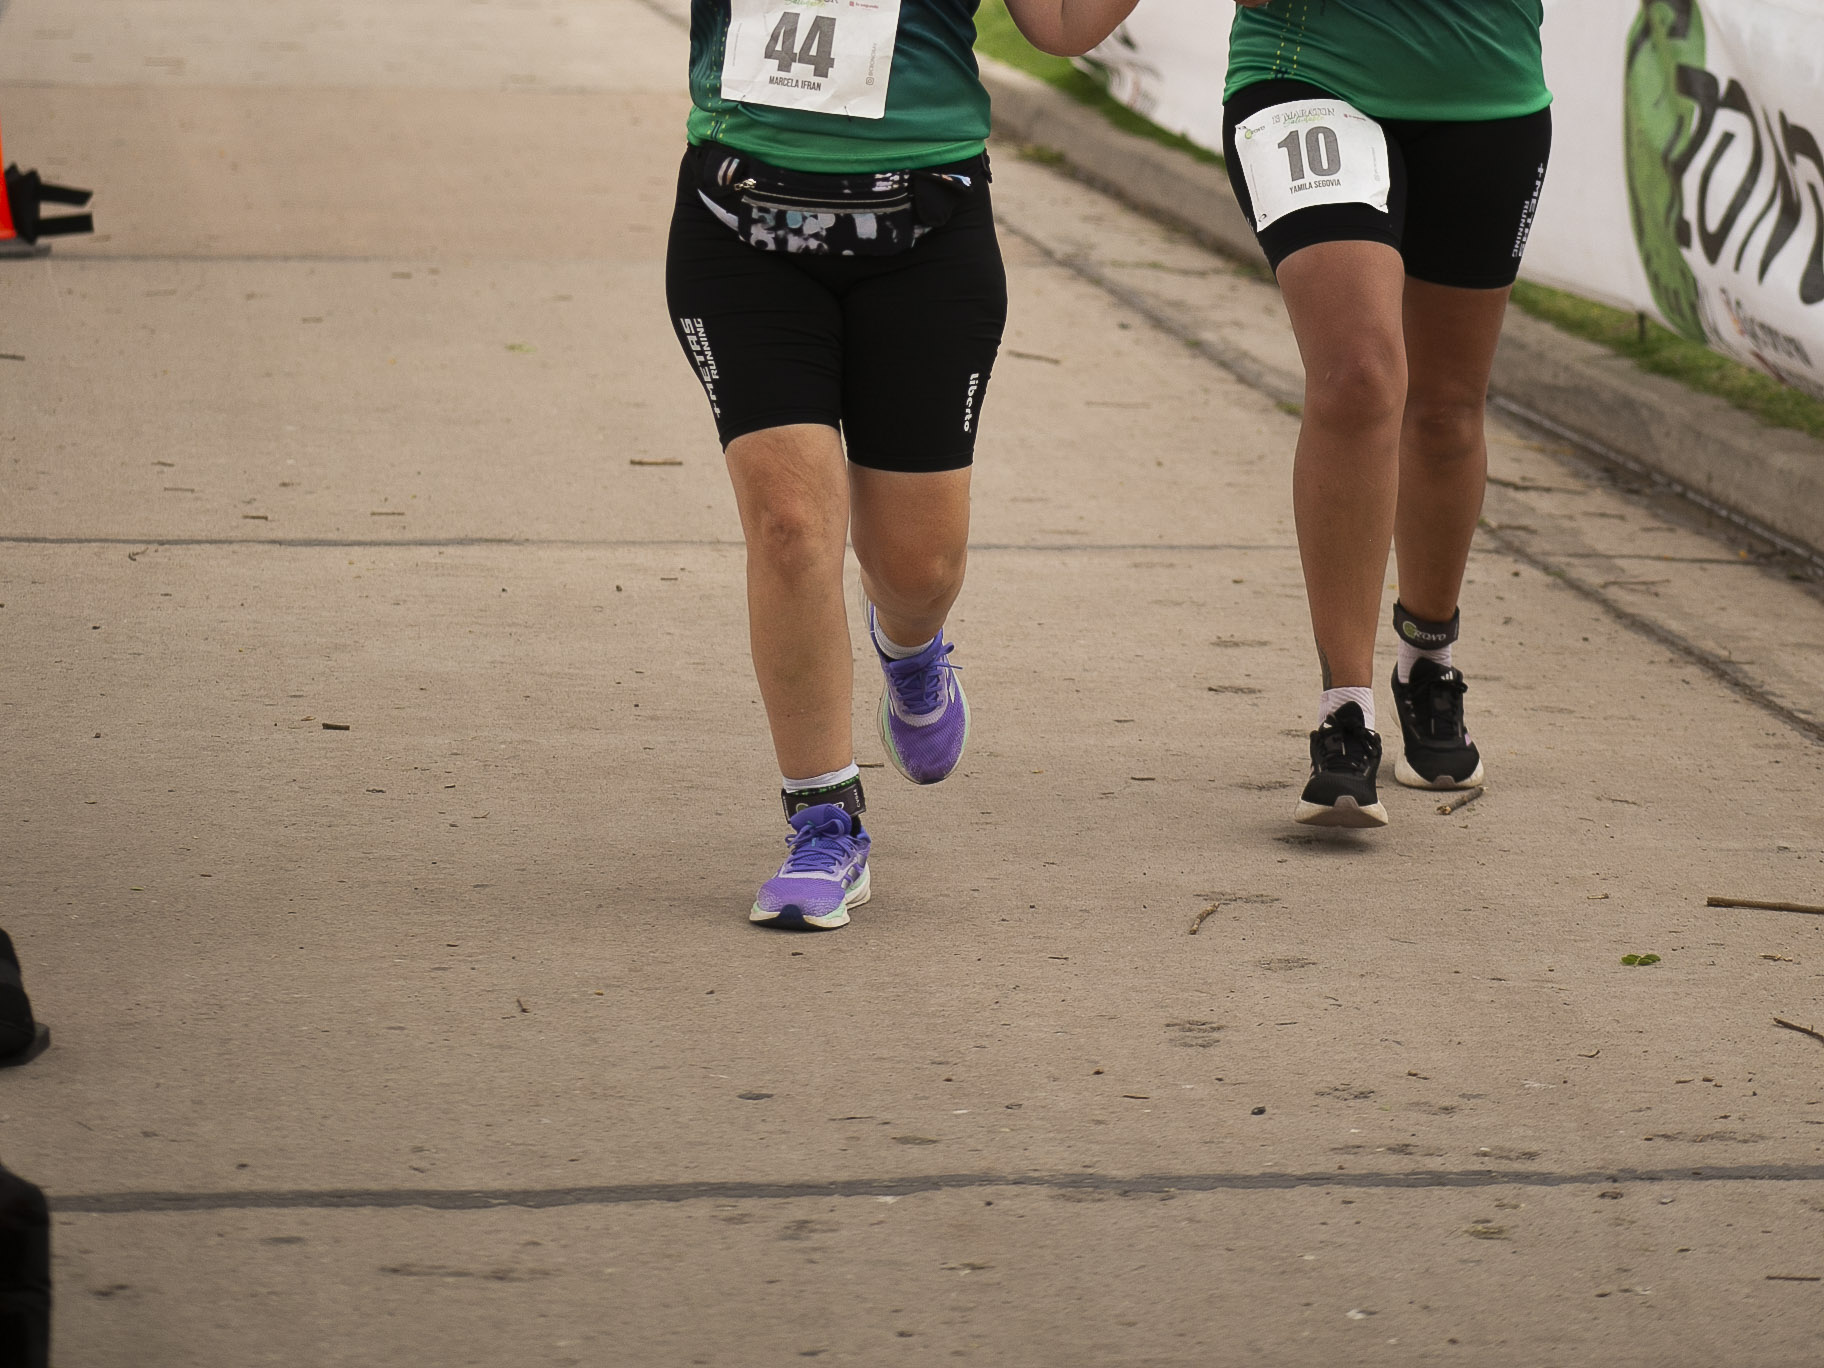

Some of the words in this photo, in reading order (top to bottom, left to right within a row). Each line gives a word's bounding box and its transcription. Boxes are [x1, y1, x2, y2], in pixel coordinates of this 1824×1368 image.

[764, 11, 836, 78] 44
[769, 76, 799, 89] MARCELA
[800, 80, 822, 92] IFRAN
[1277, 126, 1341, 182] 10
[1289, 182, 1313, 195] YAMILA
[1314, 178, 1341, 189] SEGOVIA
[693, 317, 720, 379] RUNNING
